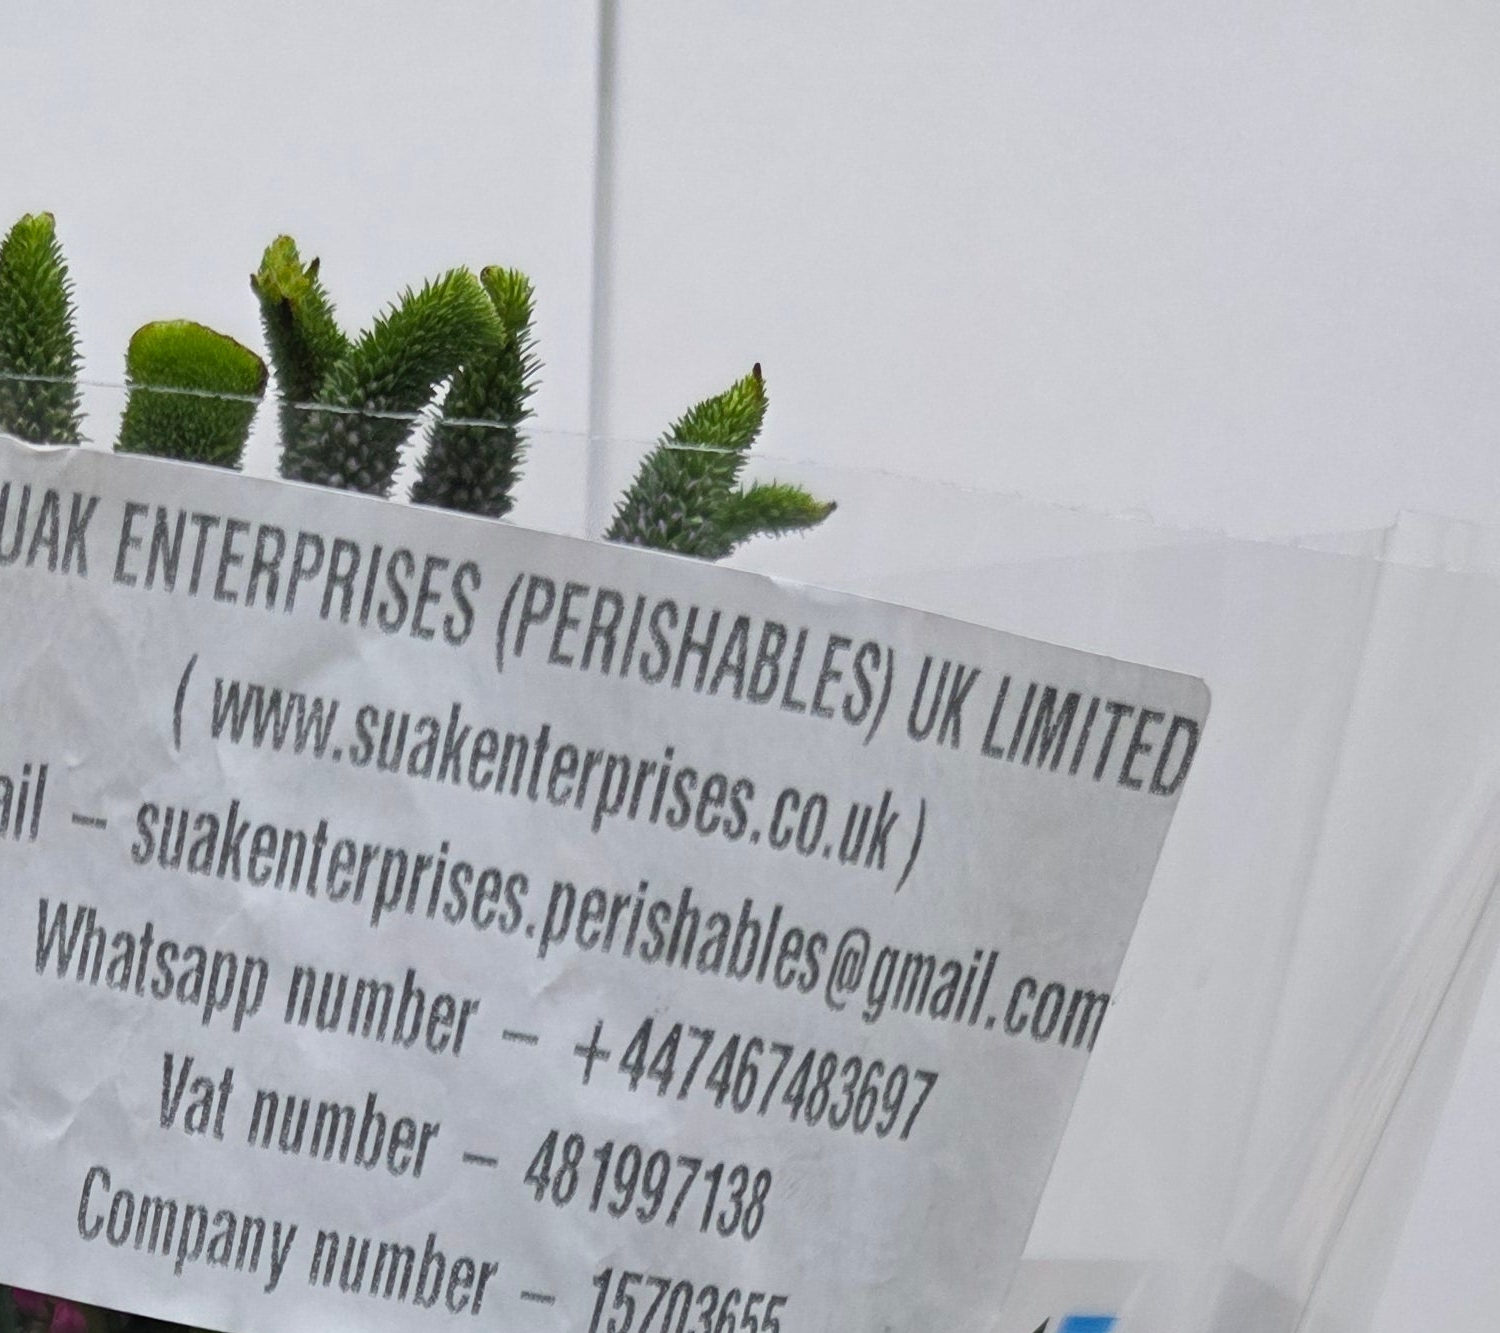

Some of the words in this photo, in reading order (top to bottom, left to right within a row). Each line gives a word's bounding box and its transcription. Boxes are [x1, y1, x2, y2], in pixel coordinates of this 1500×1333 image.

[114, 503, 481, 647] ENTERPRISES
[495, 572, 894, 745] (PERISHABLES)
[908, 656, 980, 749] UK
[982, 675, 1199, 797] LIMITED
[211, 675, 898, 870] www.suakenterprises.co.uk
[35, 898, 268, 1032] Whatsapp
[284, 962, 480, 1056] number
[574, 1017, 938, 1145] +447467483697
[131, 800, 1111, 1051] suakenterprises.perishables@gmail.com
[77, 1165, 298, 1294] Company
[309, 1227, 499, 1319] number
[159, 1052, 235, 1141] Vat
[248, 1091, 441, 1180] number
[523, 1128, 774, 1241] 481997138
